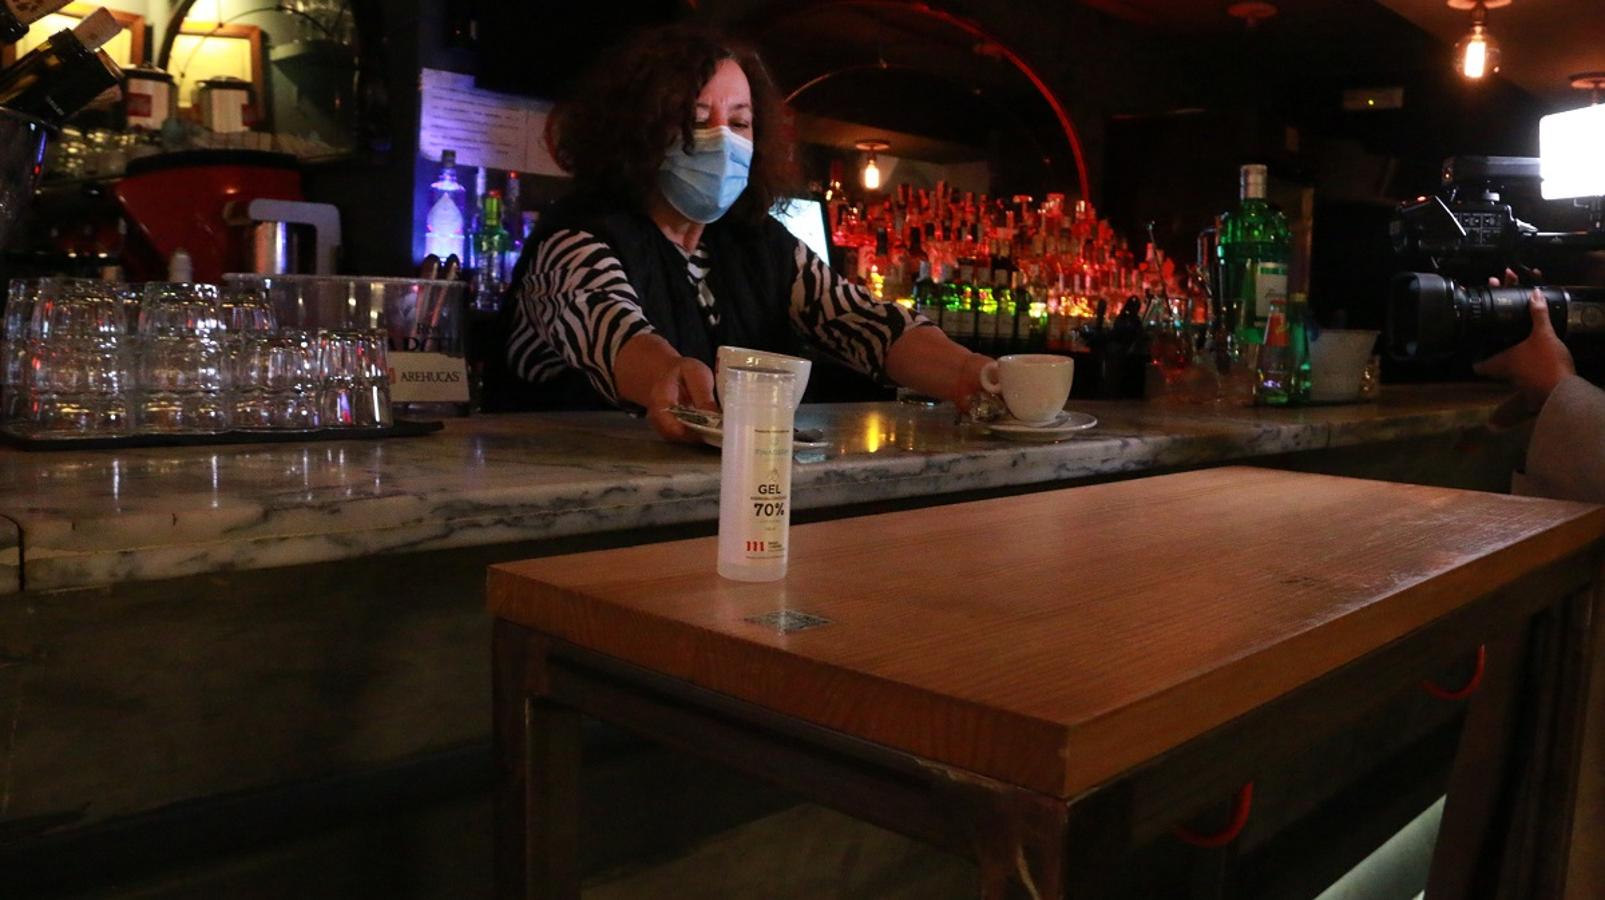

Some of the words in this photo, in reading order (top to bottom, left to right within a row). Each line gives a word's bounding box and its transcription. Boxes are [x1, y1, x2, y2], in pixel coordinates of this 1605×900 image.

[401, 371, 459, 382] AREHUCAS
[758, 484, 781, 494] GEL
[754, 503, 785, 516] 70%
